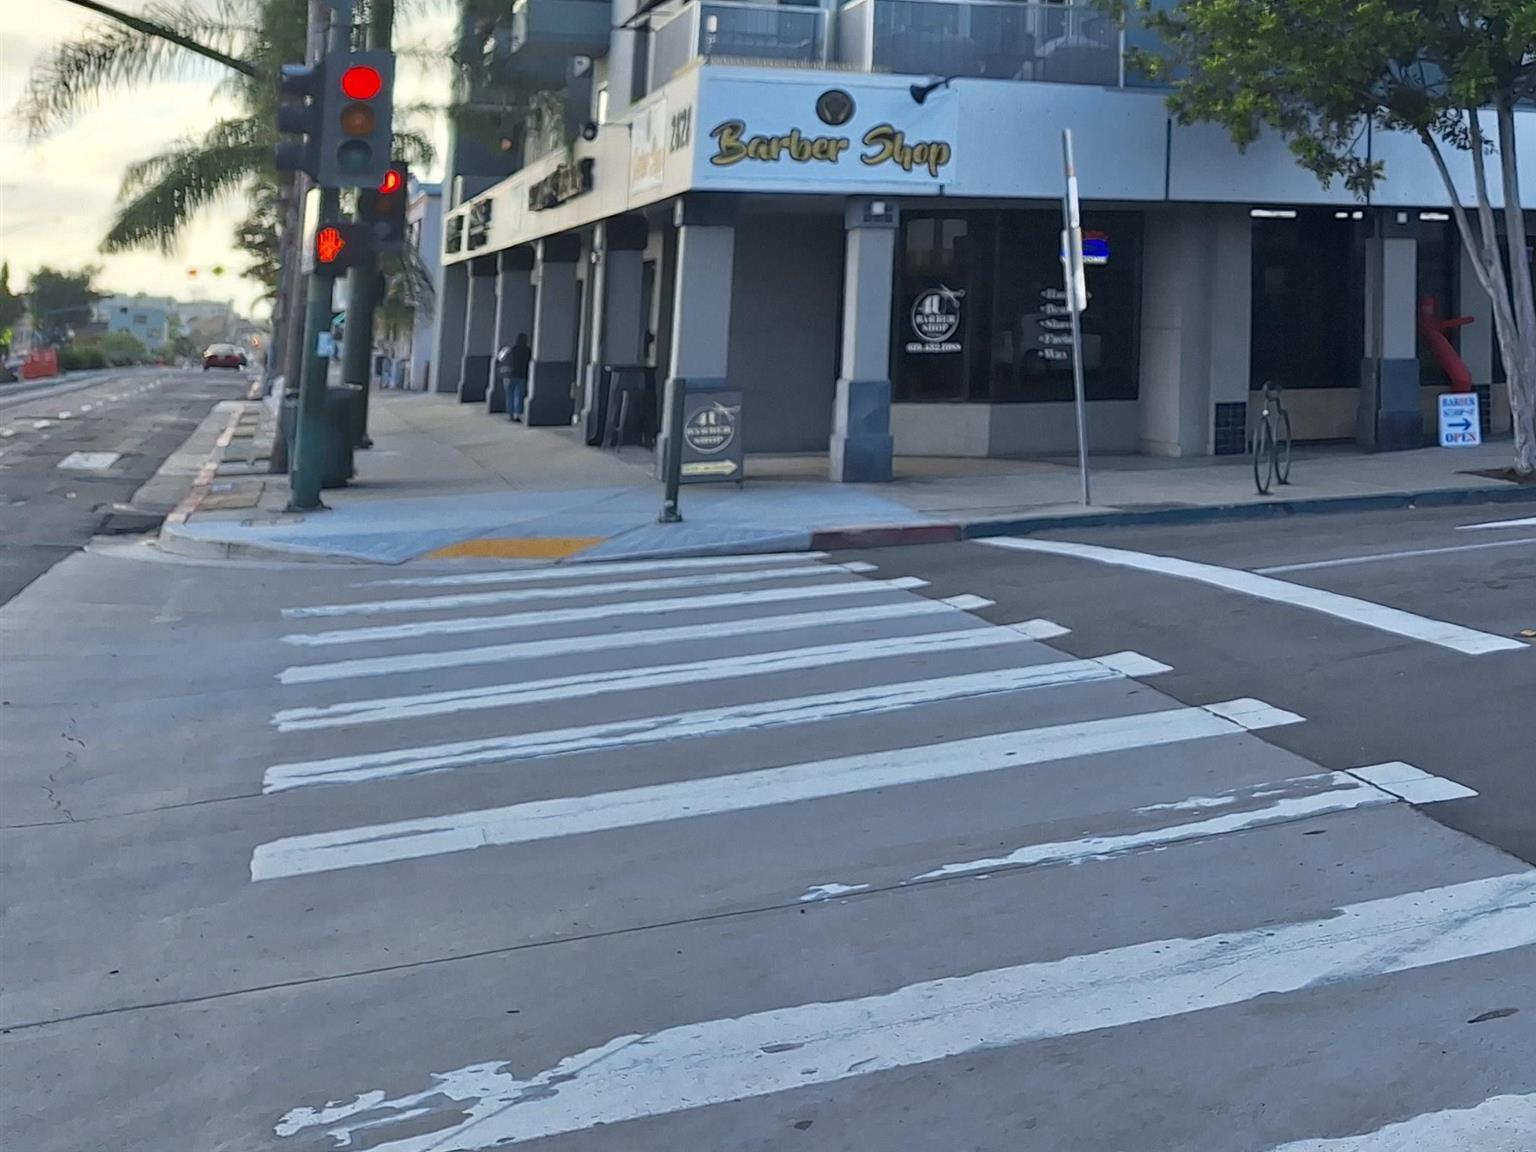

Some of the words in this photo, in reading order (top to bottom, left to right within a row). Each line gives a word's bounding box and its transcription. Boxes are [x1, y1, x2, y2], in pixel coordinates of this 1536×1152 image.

[709, 119, 850, 166] Barber
[860, 123, 951, 178] Shop
[1445, 432, 1477, 443] OPEN
